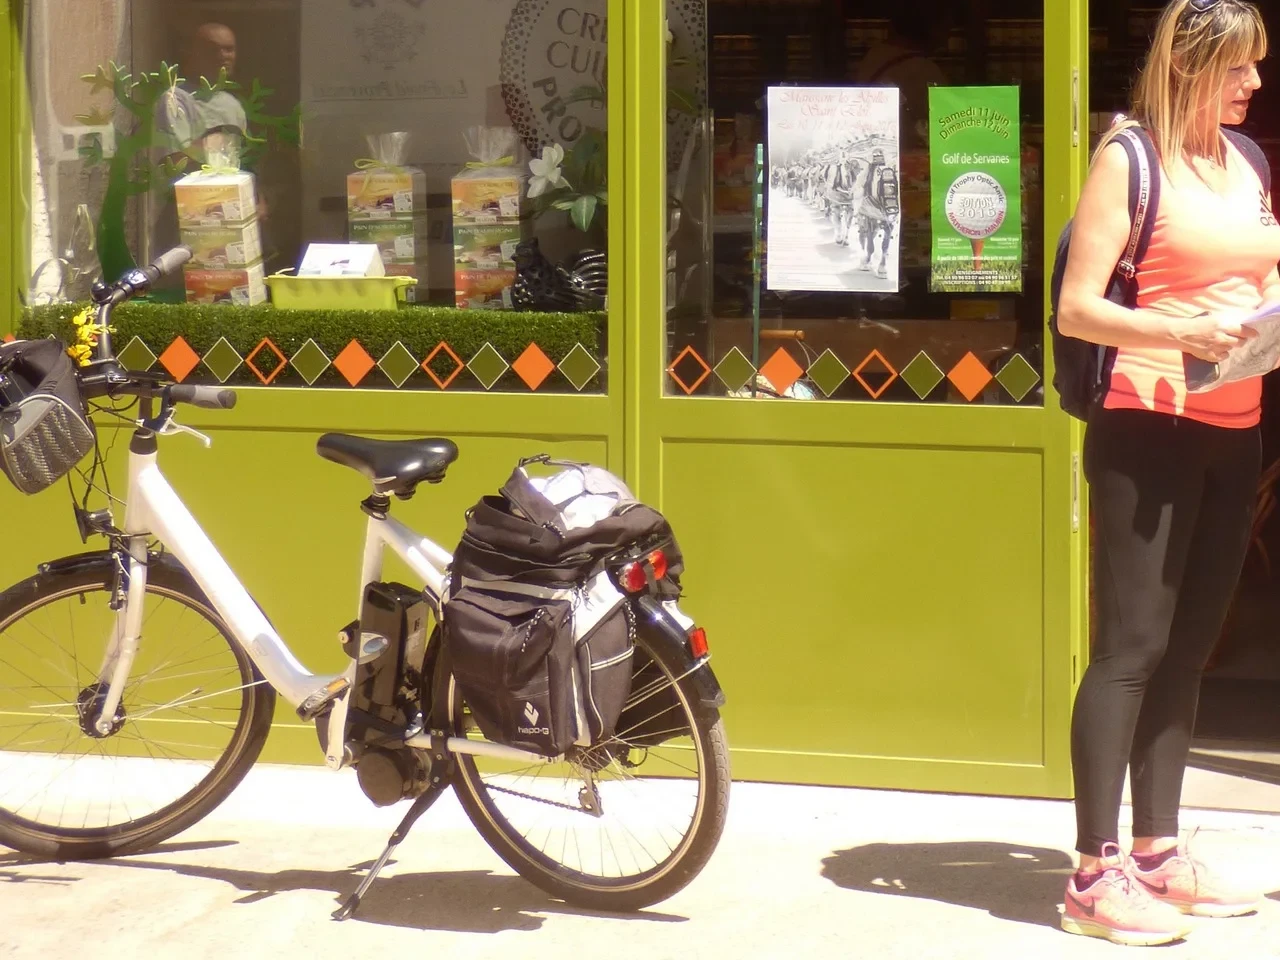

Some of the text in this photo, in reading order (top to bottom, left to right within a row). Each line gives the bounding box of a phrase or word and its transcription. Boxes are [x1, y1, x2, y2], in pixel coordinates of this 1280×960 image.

[939, 106, 1010, 127] Samedi 11 juin
[940, 117, 1009, 140] Dimanche 12 juin
[942, 152, 1010, 165] Golf de Servanes
[953, 176, 976, 190] Trophy
